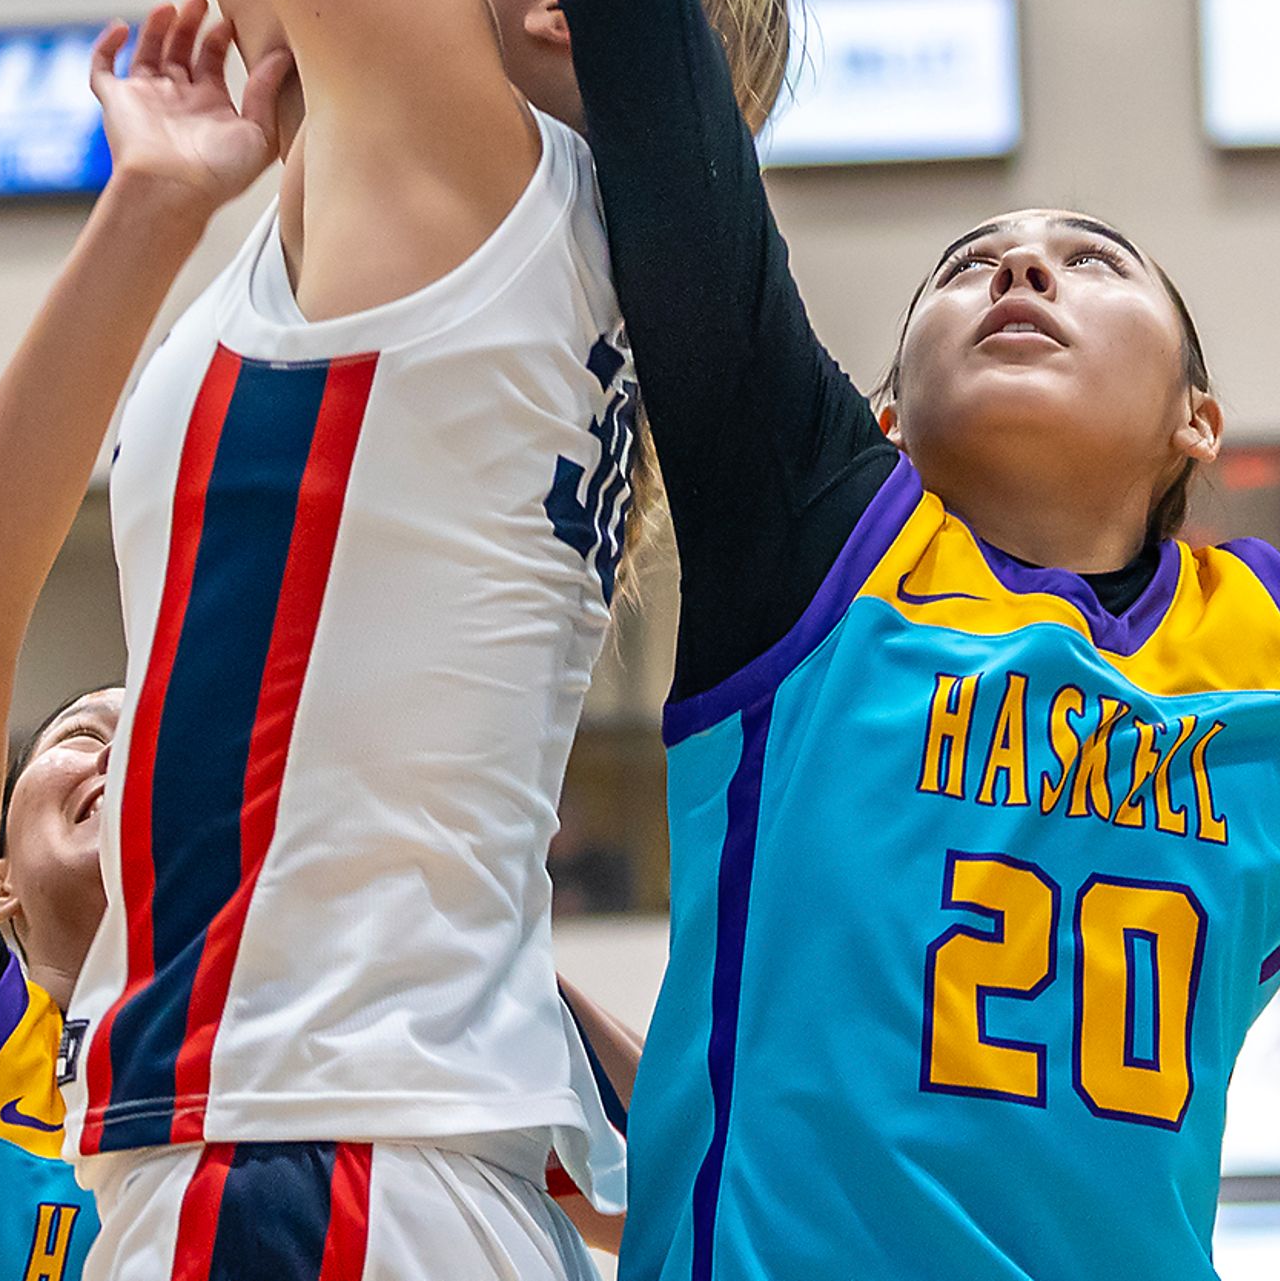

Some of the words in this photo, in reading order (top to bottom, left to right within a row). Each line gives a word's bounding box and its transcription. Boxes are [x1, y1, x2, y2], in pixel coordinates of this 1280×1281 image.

[916, 671, 1228, 846] HASKELL
[919, 848, 1209, 1133] 20
[23, 1203, 81, 1281] H
